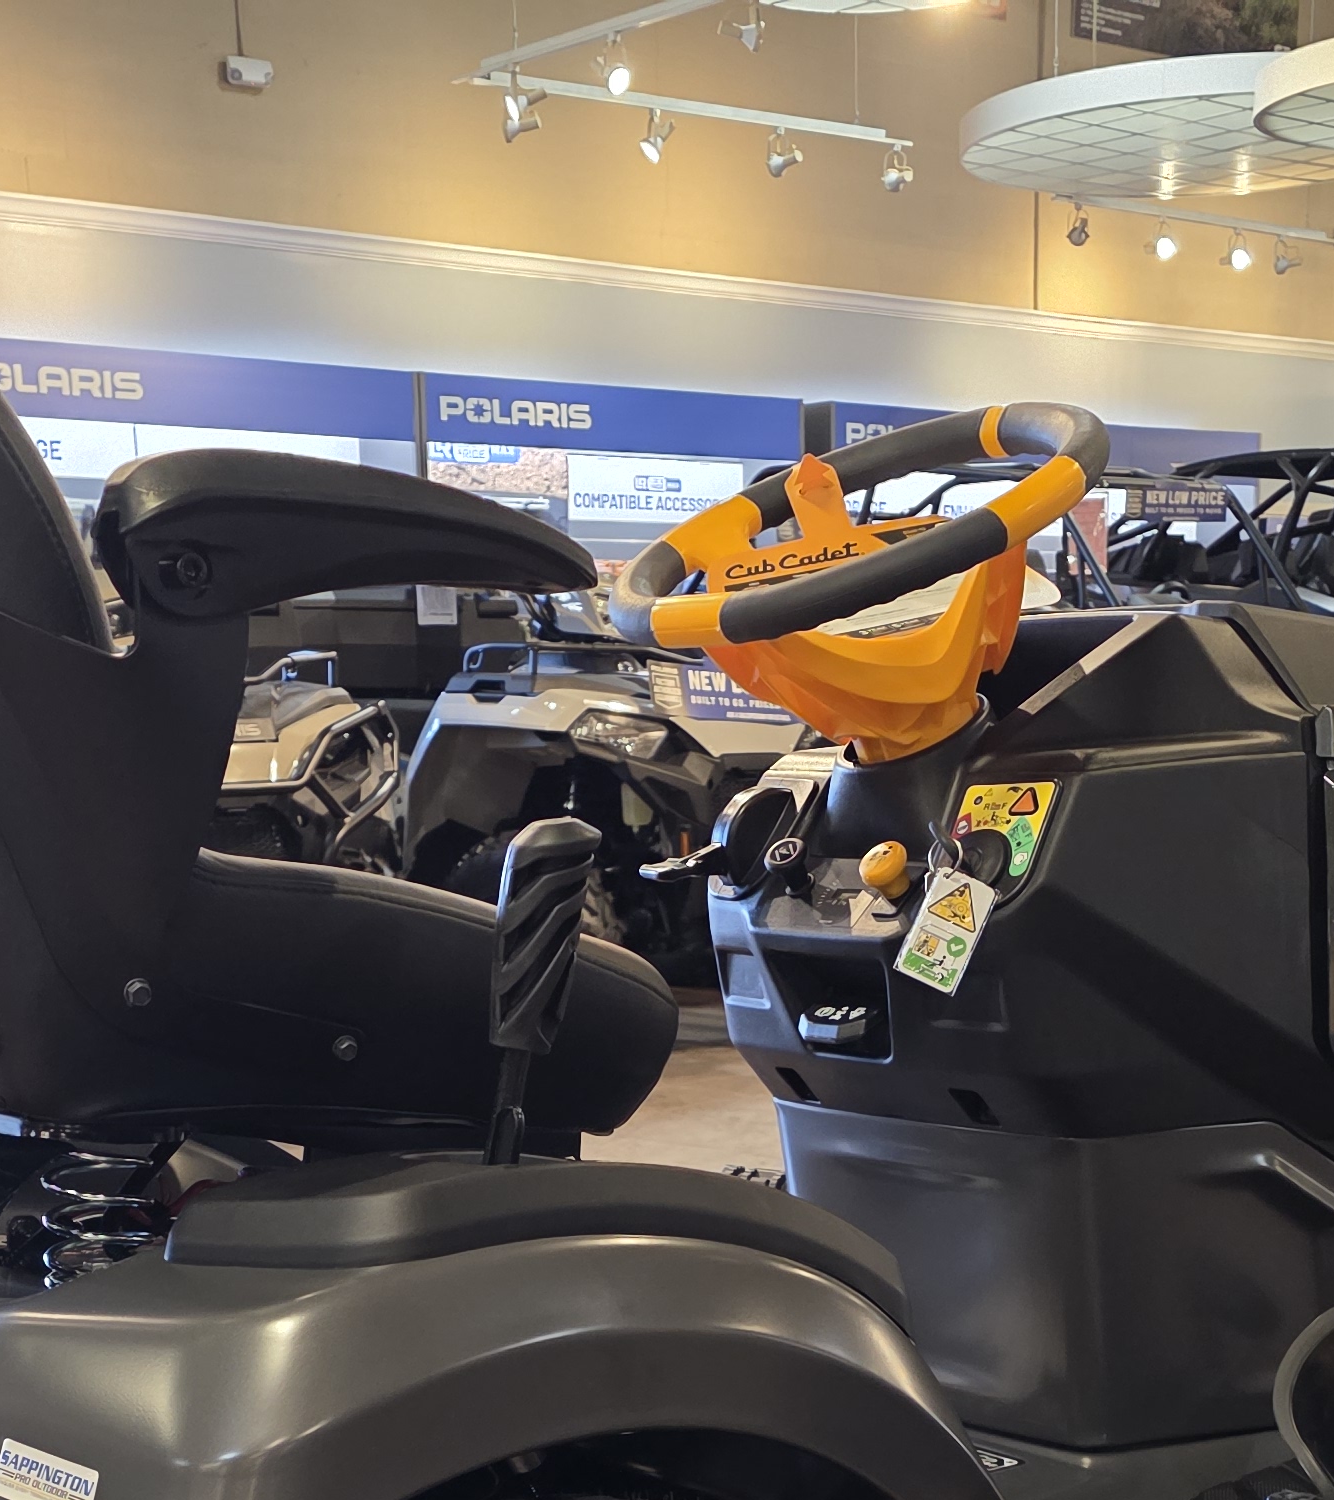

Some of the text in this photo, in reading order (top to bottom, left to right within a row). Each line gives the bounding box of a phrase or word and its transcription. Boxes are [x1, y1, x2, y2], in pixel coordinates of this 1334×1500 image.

[439, 395, 592, 430] POLARIS
[573, 492, 653, 510] COMPATIBLE
[1146, 490, 1167, 504] NEW
[1168, 491, 1189, 504] LOW
[1191, 491, 1226, 505] PRICE
[725, 542, 860, 580] Cub Cadet
[688, 669, 726, 692] NEW
[690, 695, 716, 705] BUILT
[718, 697, 730, 706] TO
[0, 1450, 95, 1496] SAPPINGTON
[14, 1473, 68, 1499] PRO OUTDOOR
